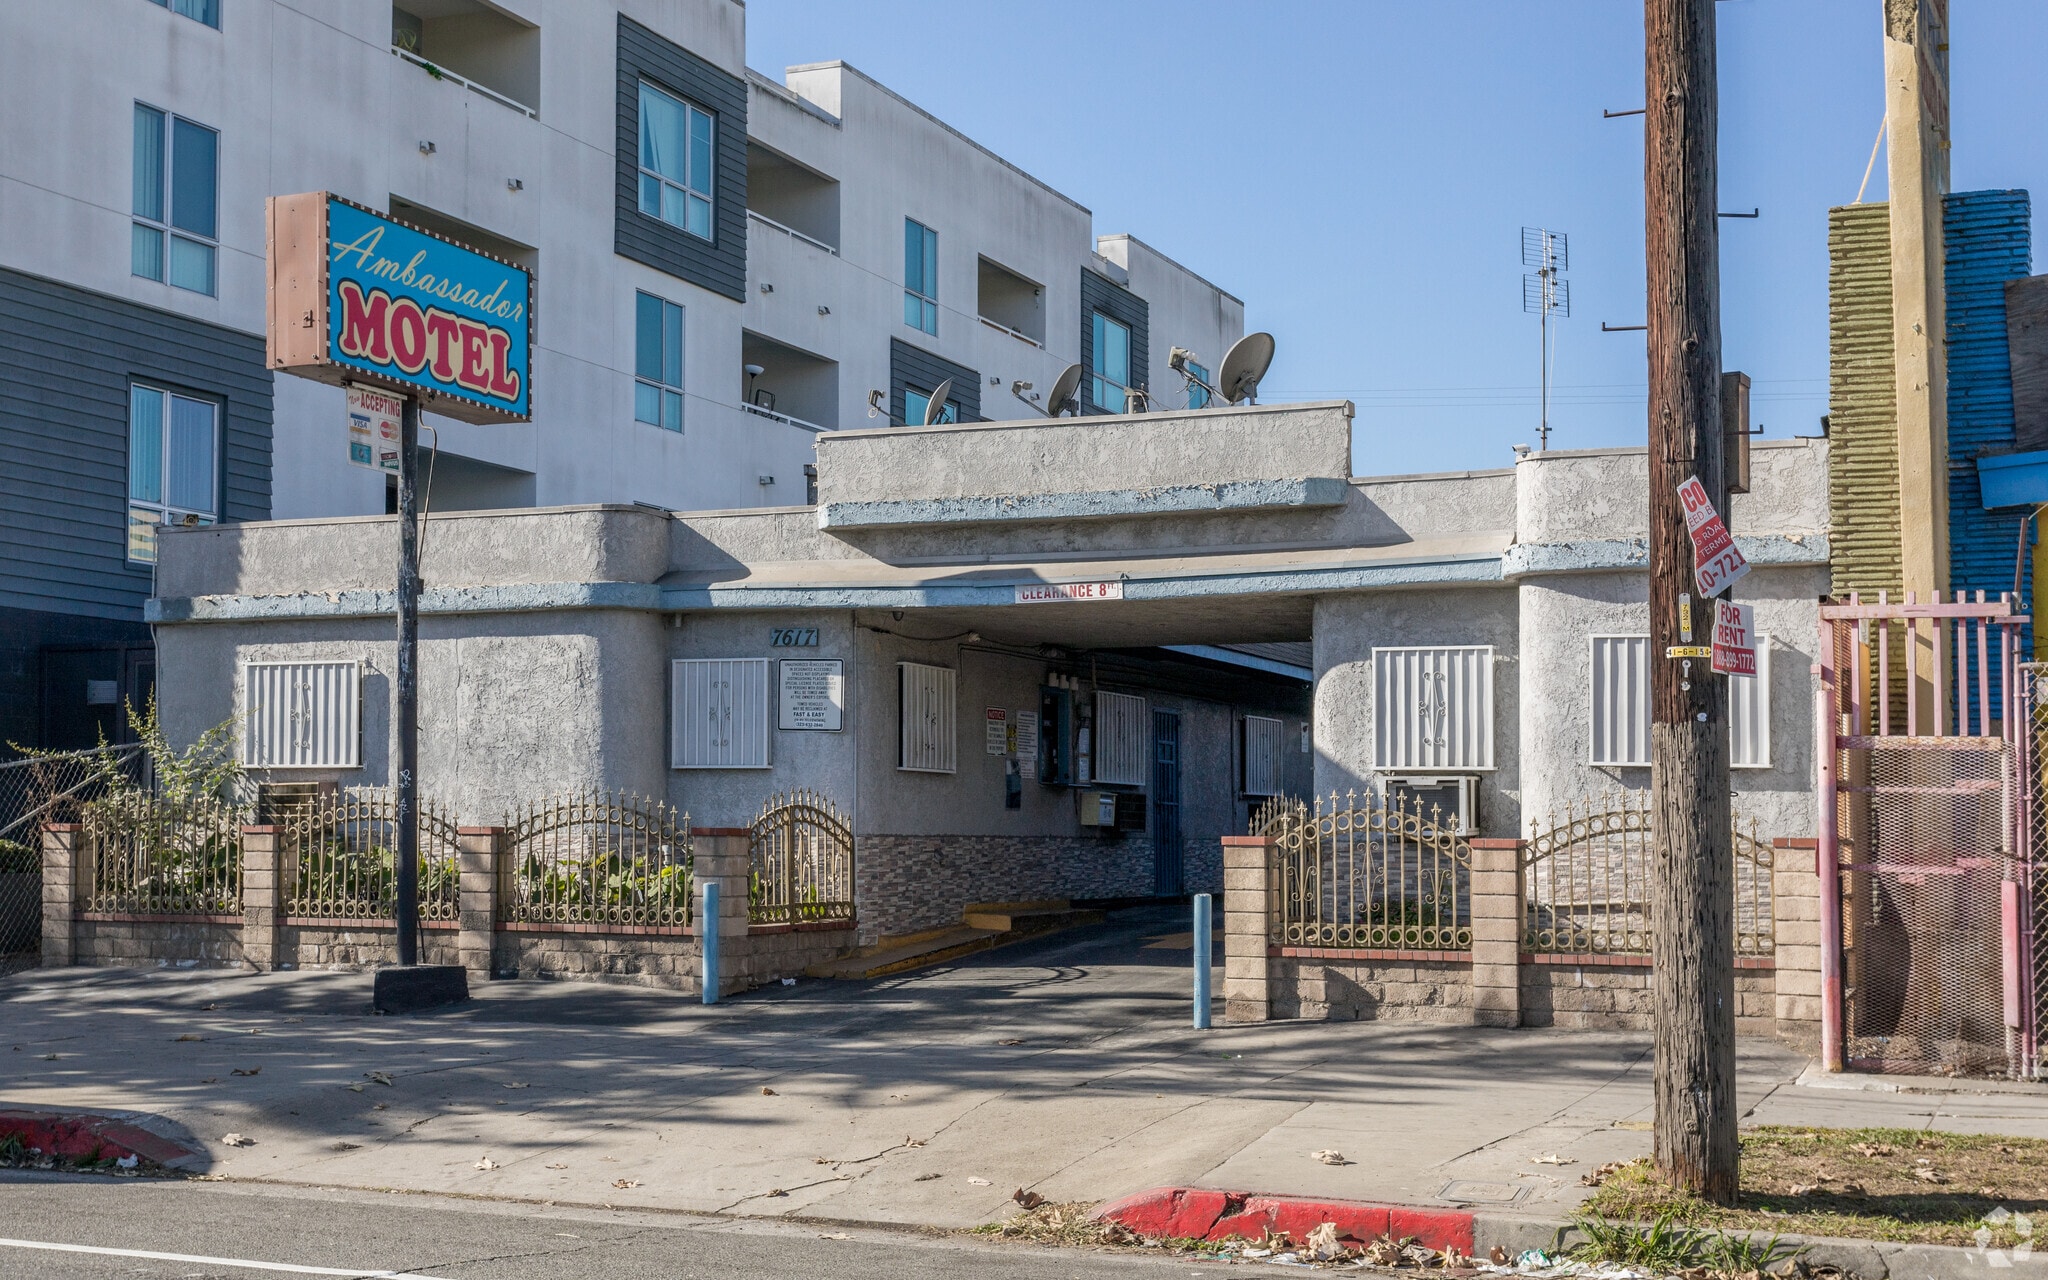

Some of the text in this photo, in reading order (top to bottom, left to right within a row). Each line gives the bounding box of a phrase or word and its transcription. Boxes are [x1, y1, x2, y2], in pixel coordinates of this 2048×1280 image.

[332, 225, 524, 323] Ambassador
[339, 281, 519, 401] MOTEL
[360, 391, 401, 418] ACCEPTING
[353, 419, 368, 429] VISA
[1021, 584, 1093, 600] CLEARANCE
[1721, 603, 1741, 626] FOR
[772, 629, 816, 647] 7617
[1718, 623, 1746, 646] RENT
